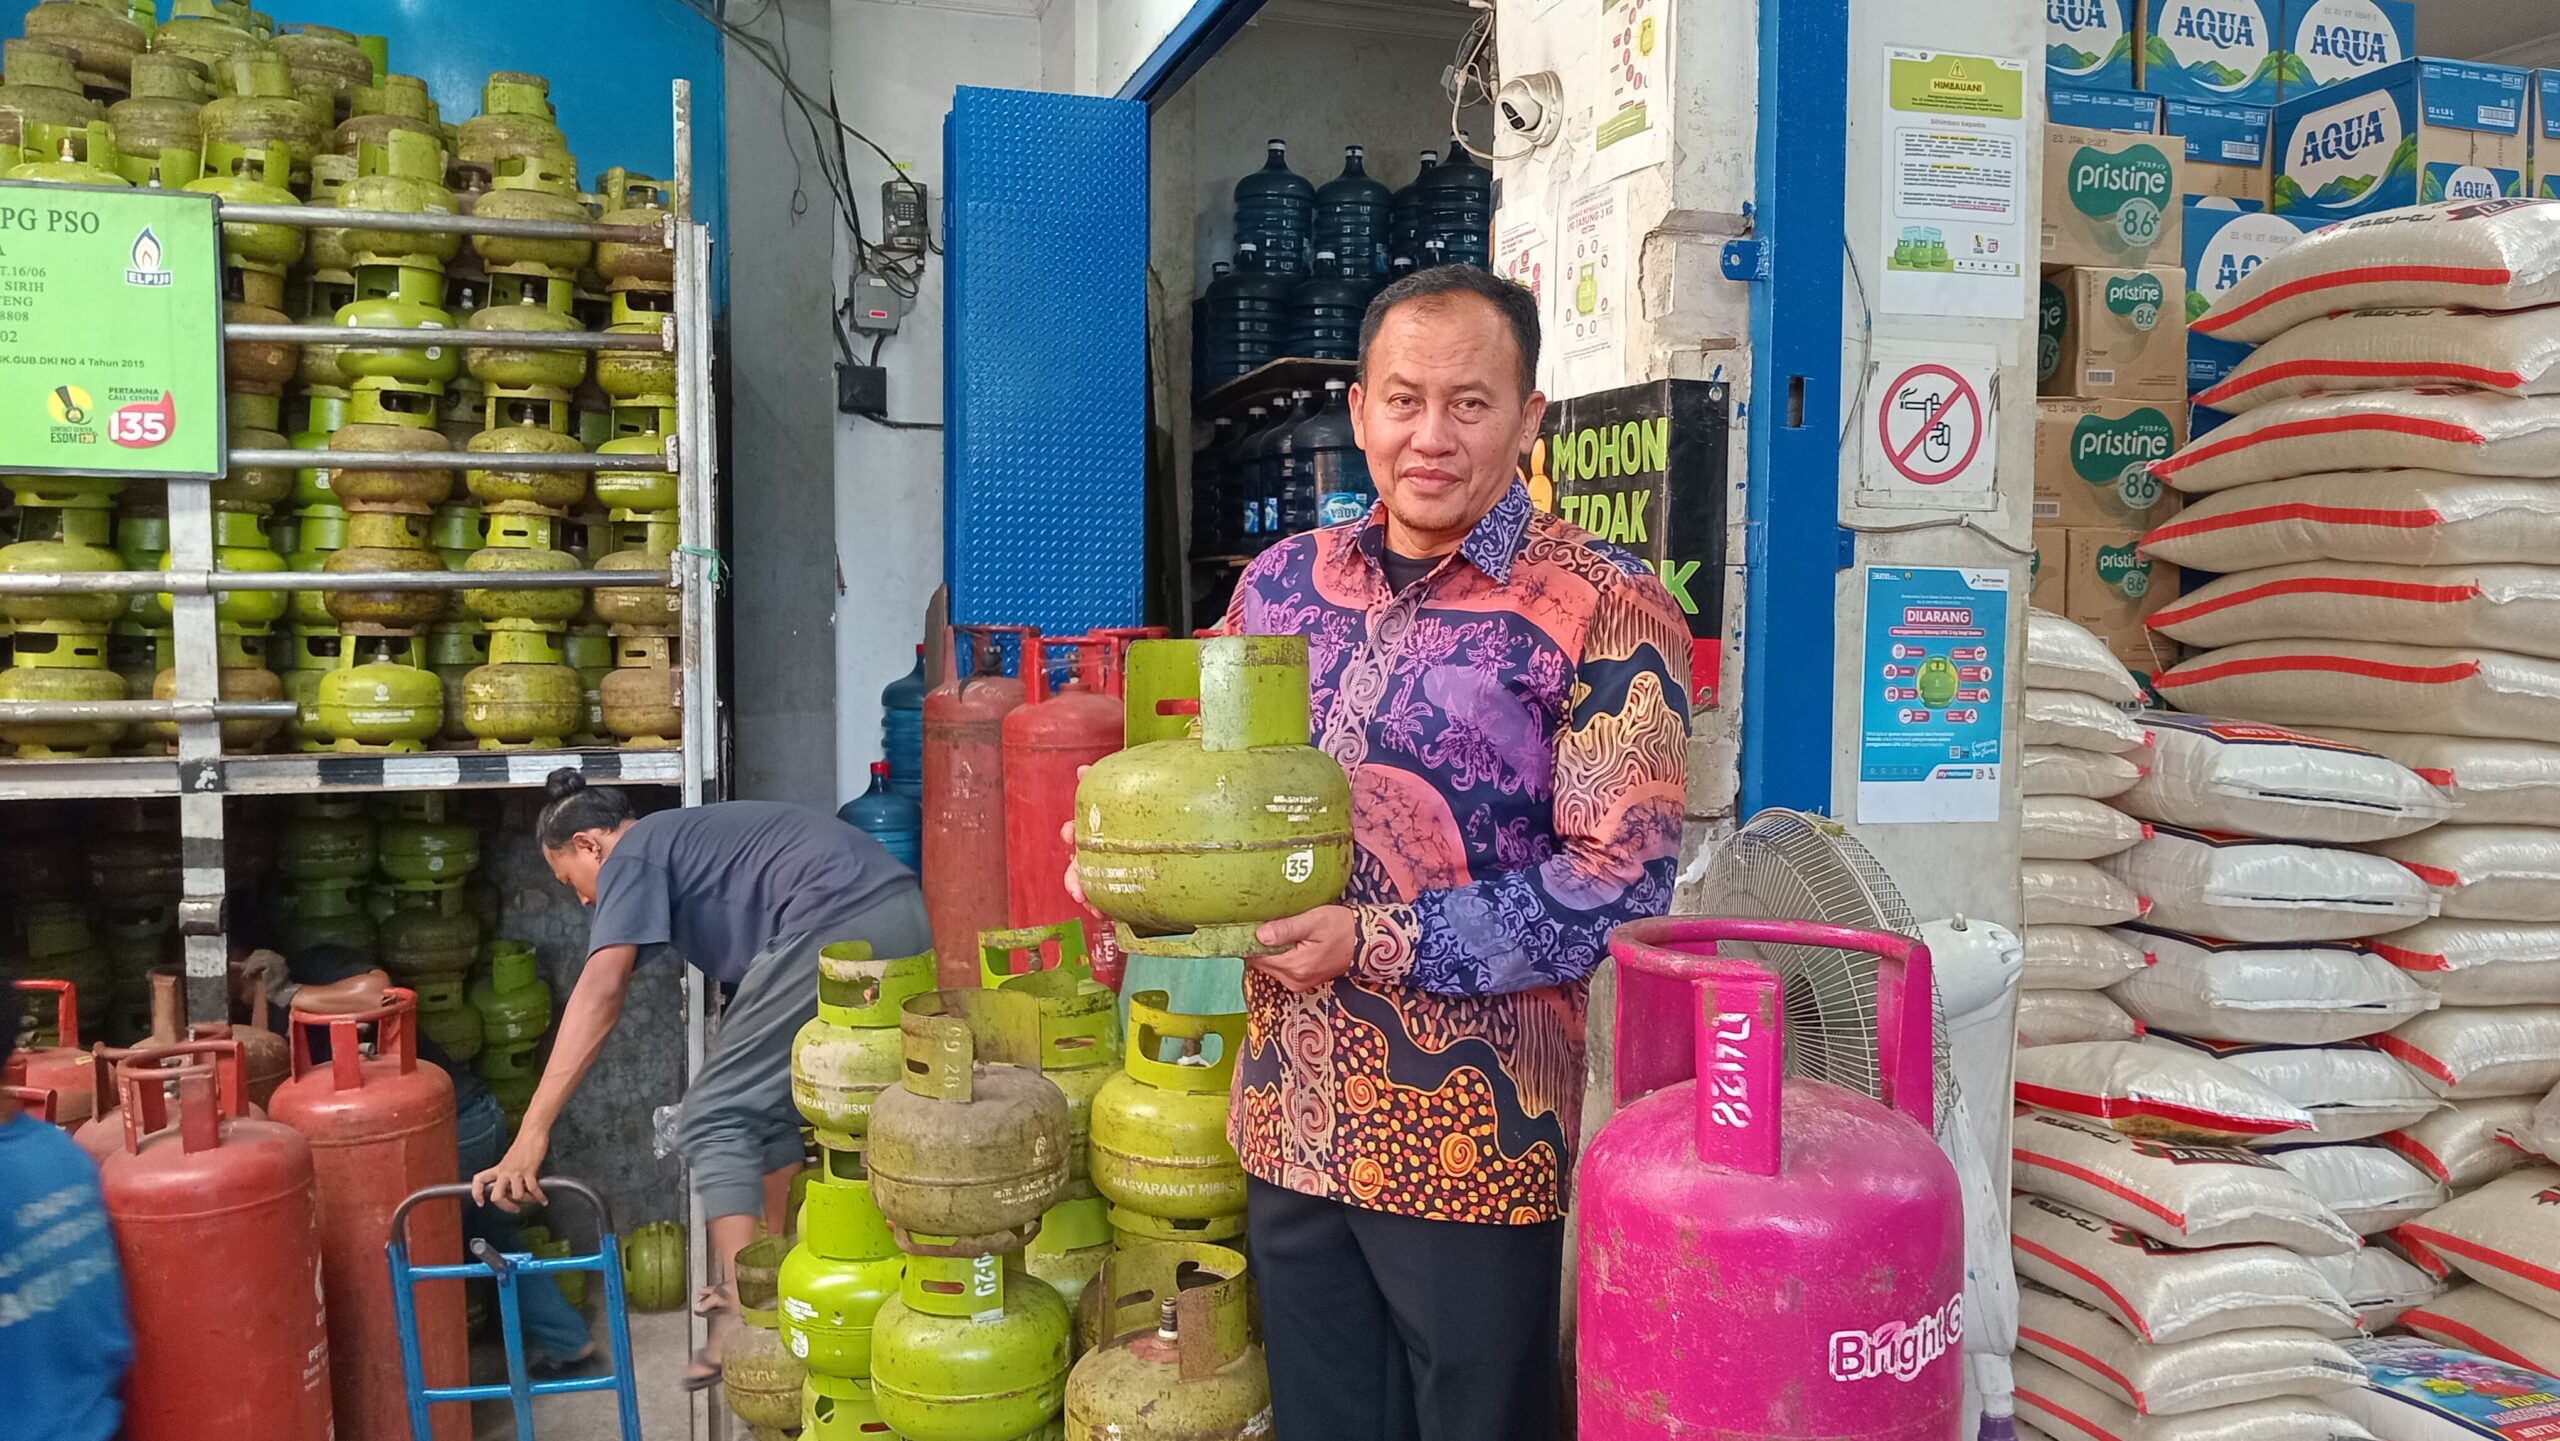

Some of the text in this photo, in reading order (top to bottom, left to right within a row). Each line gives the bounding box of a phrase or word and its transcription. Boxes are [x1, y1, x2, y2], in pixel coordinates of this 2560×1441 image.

[2046, 0, 2107, 32] QUA
[2174, 6, 2255, 49] AQUA
[2310, 25, 2387, 66] AQUA
[2300, 109, 2386, 167] AQUA
[2077, 163, 2166, 195] pristine
[2452, 180, 2493, 199] AQUA
[47, 209, 100, 234] PSO
[4, 281, 44, 292] SIRIH
[127, 272, 172, 285] ELPIJI
[2110, 285, 2160, 303] pristine
[60, 357, 77, 366] NO
[79, 358, 85, 366] 4
[88, 358, 119, 367] Tahun
[121, 360, 145, 368] 2015
[108, 387, 159, 395] PERTAMINA
[51, 432, 78, 443] ESDM
[110, 411, 166, 442] 135
[1552, 417, 1668, 482] MOHON
[2079, 429, 2168, 460] pristine
[1561, 490, 1651, 544] TIDAK
[1907, 610, 1970, 623] DILARANG
[839, 1101, 873, 1115] MISKI
[1829, 1305, 1945, 1382] Bright
